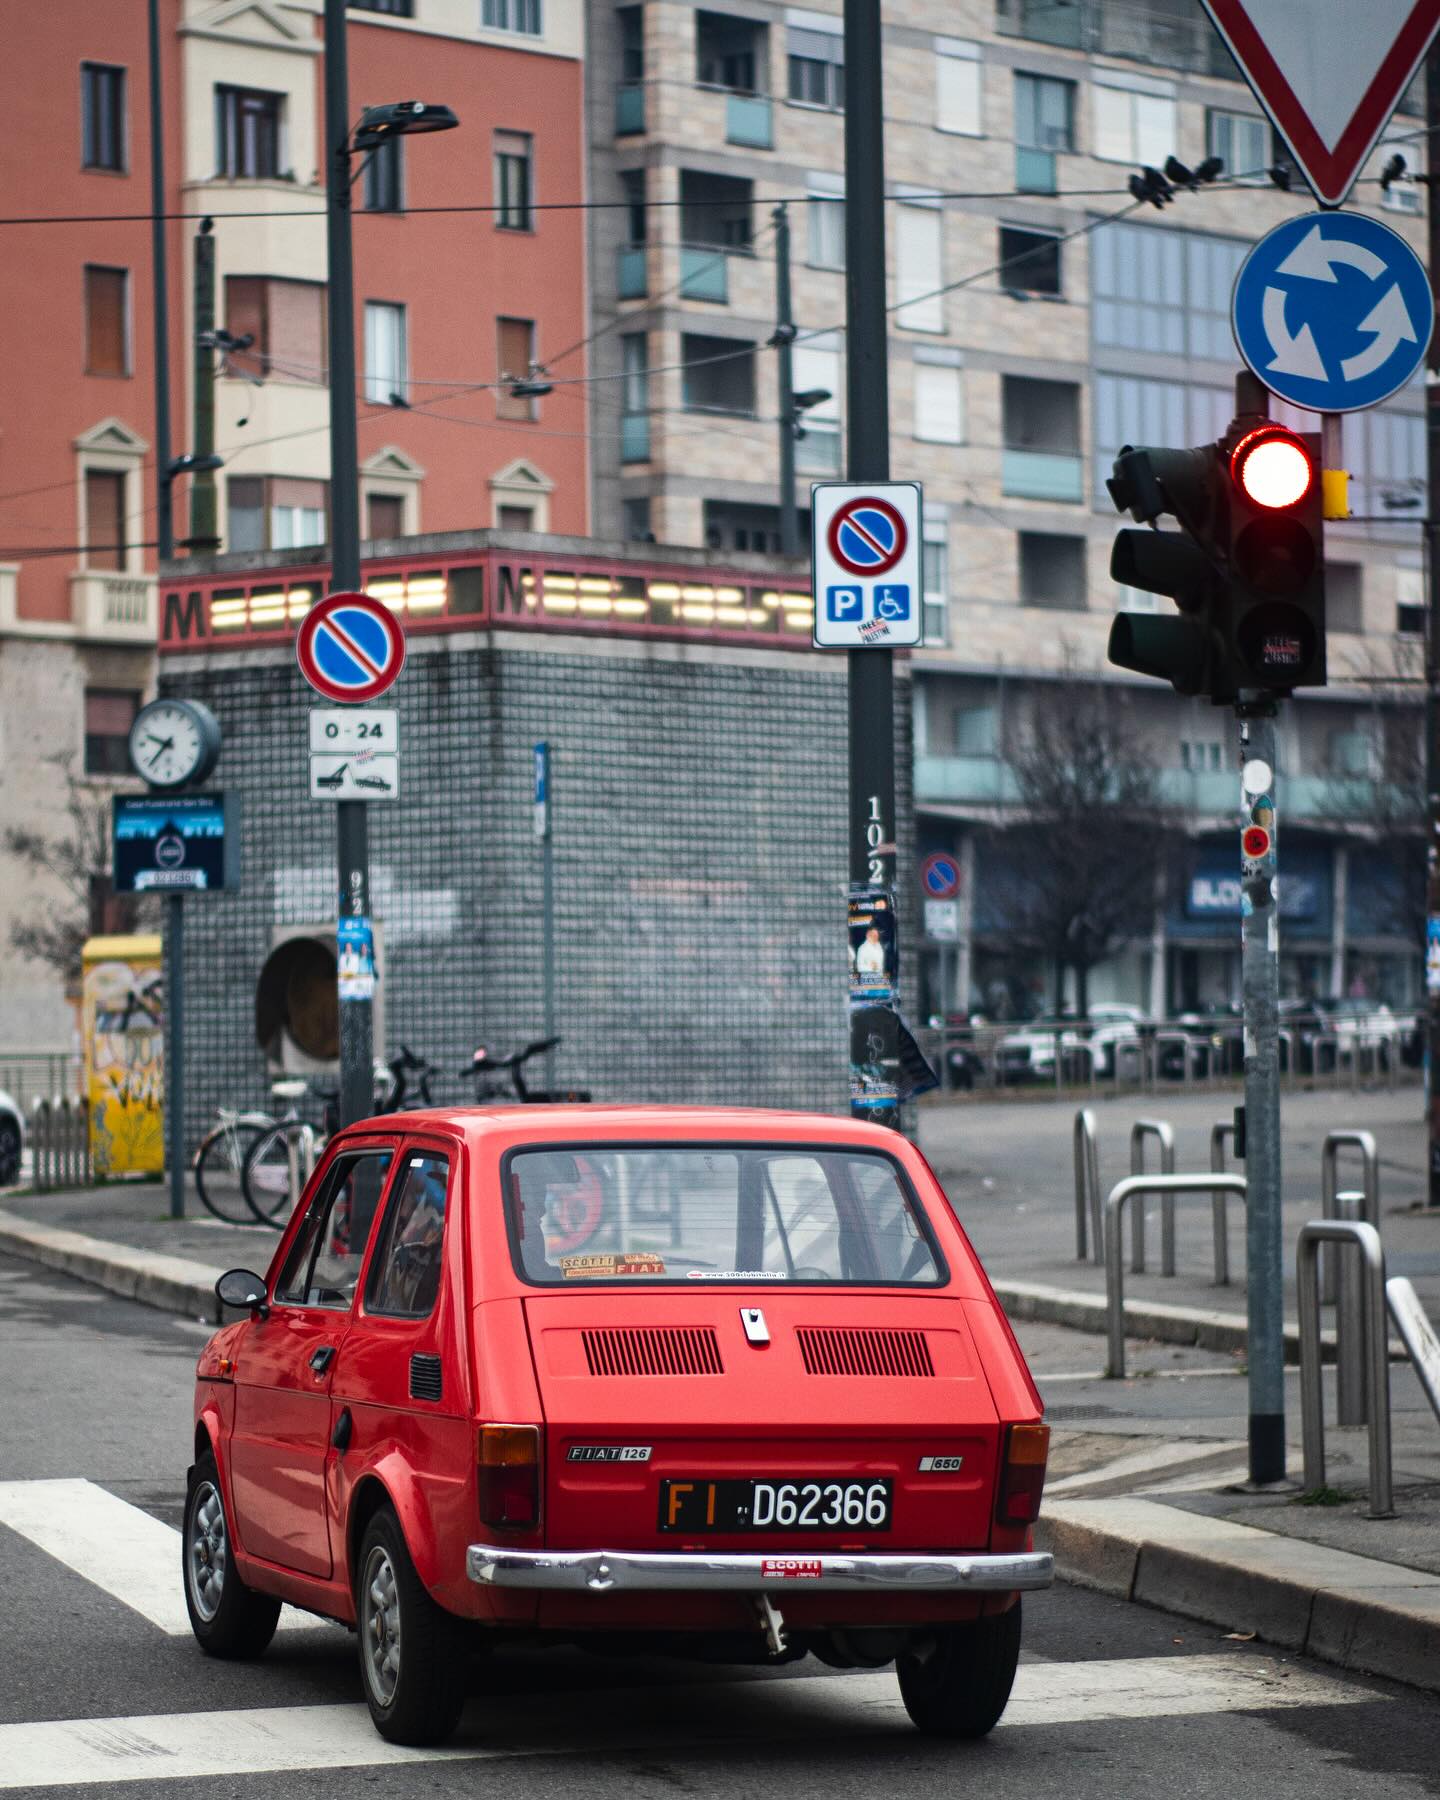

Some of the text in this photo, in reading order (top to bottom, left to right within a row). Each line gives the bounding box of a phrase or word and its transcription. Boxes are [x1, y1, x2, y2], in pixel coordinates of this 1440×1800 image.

[834, 590, 856, 618] P
[163, 591, 206, 641] M
[325, 722, 339, 738] 0
[357, 722, 383, 738] 24
[564, 1256, 613, 1268] SCOTTI
[617, 1264, 661, 1273] FIAT
[571, 1448, 648, 1459] FIAT 126
[934, 1458, 960, 1469] 650
[753, 1484, 887, 1525] D62366
[766, 1560, 818, 1569] SCOTTI
